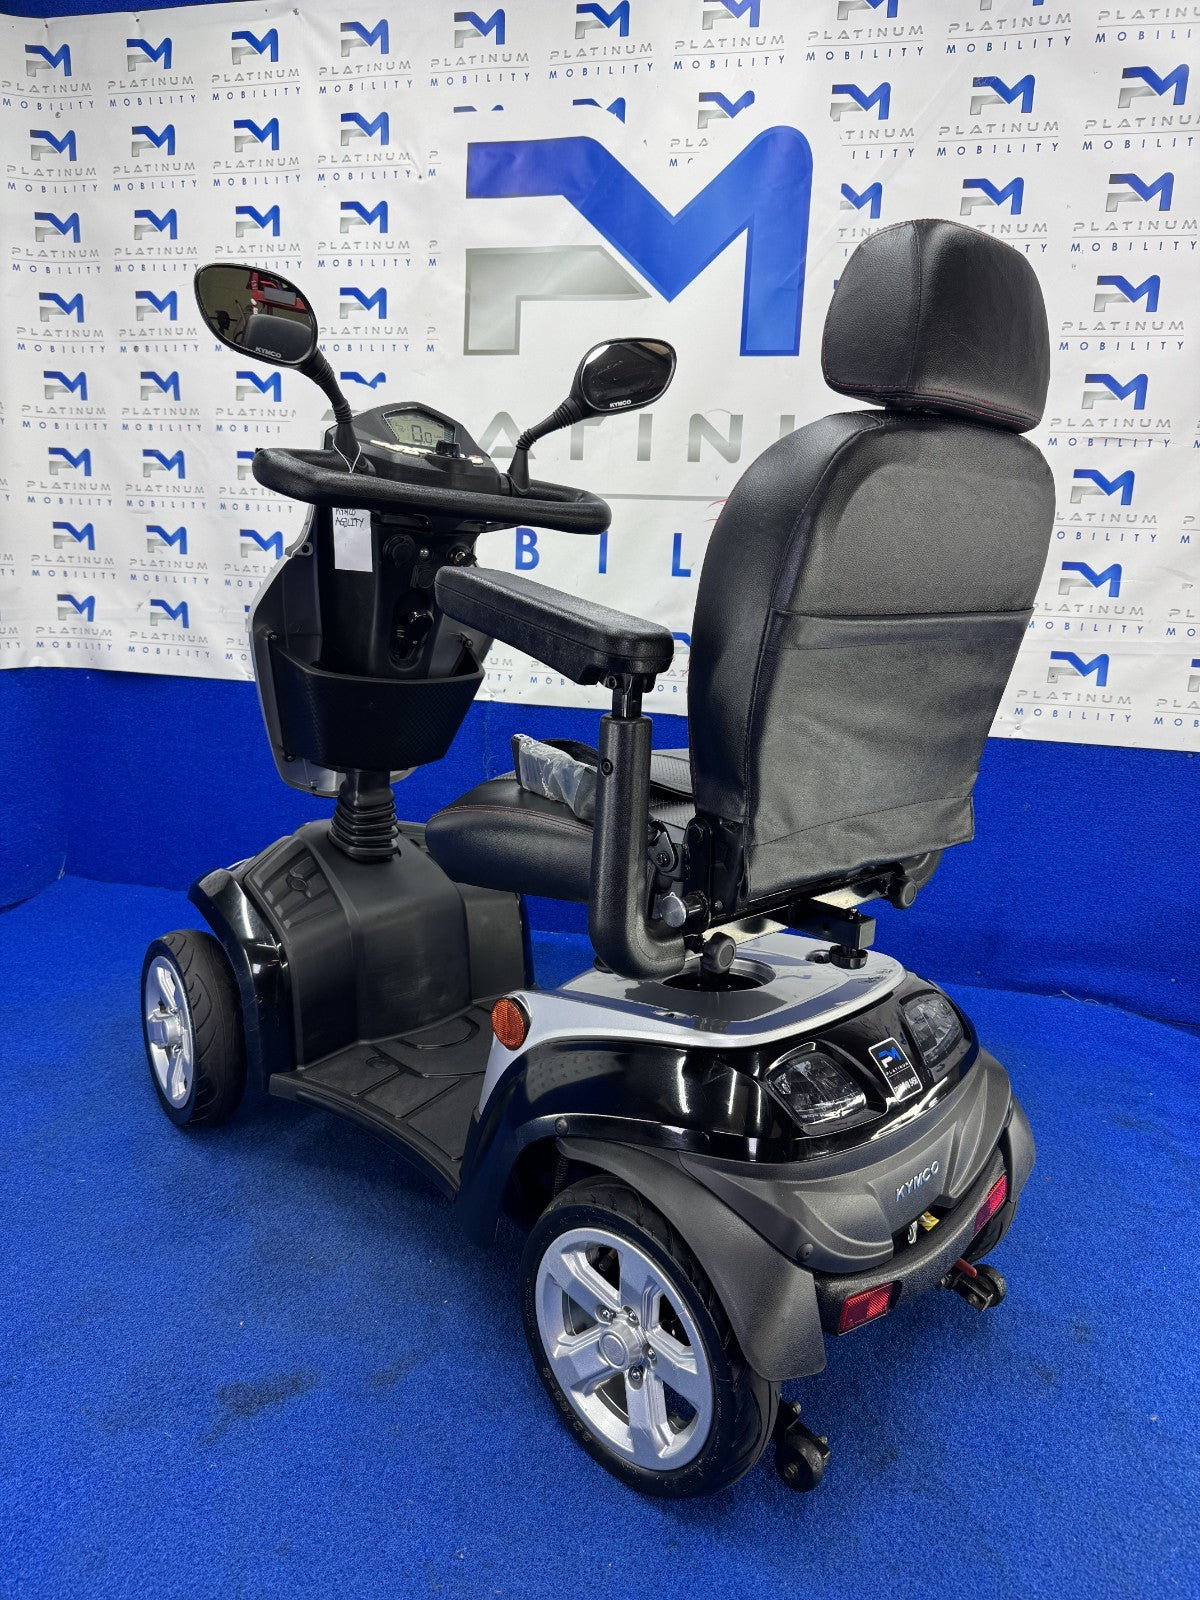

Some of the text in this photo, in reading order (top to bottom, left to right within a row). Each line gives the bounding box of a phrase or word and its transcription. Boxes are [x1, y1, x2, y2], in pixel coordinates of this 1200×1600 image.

[1098, 6, 1200, 21] PLATINU
[948, 13, 1072, 33] PLATINUM
[807, 25, 924, 41] PLATINUM
[1094, 29, 1192, 44] MOBILI
[674, 34, 785, 50] PLATINUM
[946, 36, 1071, 54] MOBILITY
[549, 42, 653, 61] PLATINUM
[805, 47, 924, 62] MOBILITY
[430, 52, 530, 68] PLATINUM
[673, 54, 785, 71] MOBILITY
[318, 59, 412, 77] PLATINUM
[548, 62, 654, 80] MOBILITY
[211, 67, 300, 84] PLATINUM
[429, 72, 531, 87] MOBILITY
[1, 80, 92, 94] PLATINUM
[107, 75, 194, 90] PLATINUM
[318, 79, 413, 95] MOBILITY
[211, 86, 301, 101] MOBILITY
[2, 97, 94, 112] MOBILITY
[109, 94, 196, 108] MOBILITY
[843, 127, 915, 141] TINUM
[938, 120, 1059, 136] PLATINUM
[936, 142, 1059, 157] MOBILITY
[1081, 136, 1194, 152] MOBILIT
[317, 151, 411, 165] PLATINUM
[851, 147, 915, 161] ILITY
[112, 161, 196, 175] PLATINUM
[212, 156, 300, 170] PLATINUM
[6, 164, 97, 177] PLATINUM
[317, 168, 412, 182] MOBILITY
[113, 179, 197, 192] MOBILITY
[212, 173, 301, 187] MOBILITY
[7, 181, 98, 194] MOBILITY
[1072, 219, 1198, 232] PLATINUM
[113, 246, 198, 256] PLATINUM
[214, 242, 301, 254] PLATINUM
[317, 240, 410, 251] PLATINUM
[1070, 240, 1198, 253] MOBILITY
[11, 246, 100, 259] PLATINUM
[11, 263, 101, 275] MOBILITY
[114, 263, 199, 273] MOBILITY
[317, 258, 411, 268] MOBILITY
[16, 326, 104, 338] PLATINUM
[118, 327, 198, 338] PLATINUM
[318, 326, 409, 336] PLATINUM
[1060, 320, 1185, 332] PLATINUM
[17, 342, 106, 354] MOBILITY
[255, 346, 282, 358] KYMCO
[319, 343, 410, 353] MOBILITY
[1058, 340, 1185, 352] MOBILITY
[21, 404, 107, 416] PLATINUM
[609, 399, 632, 408] KYMCO
[121, 407, 200, 416] PLATINUM
[21, 420, 108, 431] MOBILITY
[121, 423, 202, 432] MOBILITY
[215, 423, 281, 435] MOBILI
[1049, 417, 1172, 429] PLATINUM
[1046, 437, 1172, 449] MOBILITY
[26, 480, 111, 491] PLATINUM
[124, 483, 205, 494] PLATINUM
[26, 495, 113, 507] MOBILITY
[125, 499, 207, 510] MOBILITY
[219, 503, 293, 513] MOBILIT
[1055, 511, 1158, 525] LATINUM
[1055, 530, 1158, 544] OBILITY
[30, 554, 115, 566] PLATINUM
[129, 558, 208, 570] PLATINUM
[31, 569, 117, 580] MOBILITY
[129, 573, 210, 585] MOBILITY
[35, 626, 112, 636] PLATINUM
[129, 630, 209, 644] PLATINUM
[35, 640, 113, 652] MOBILITY
[127, 645, 210, 659] MOBILITY
[1016, 689, 1132, 705] PLATINUM
[1013, 707, 1132, 724] MOBILITY
[895, 1160, 940, 1203] KYMCO
